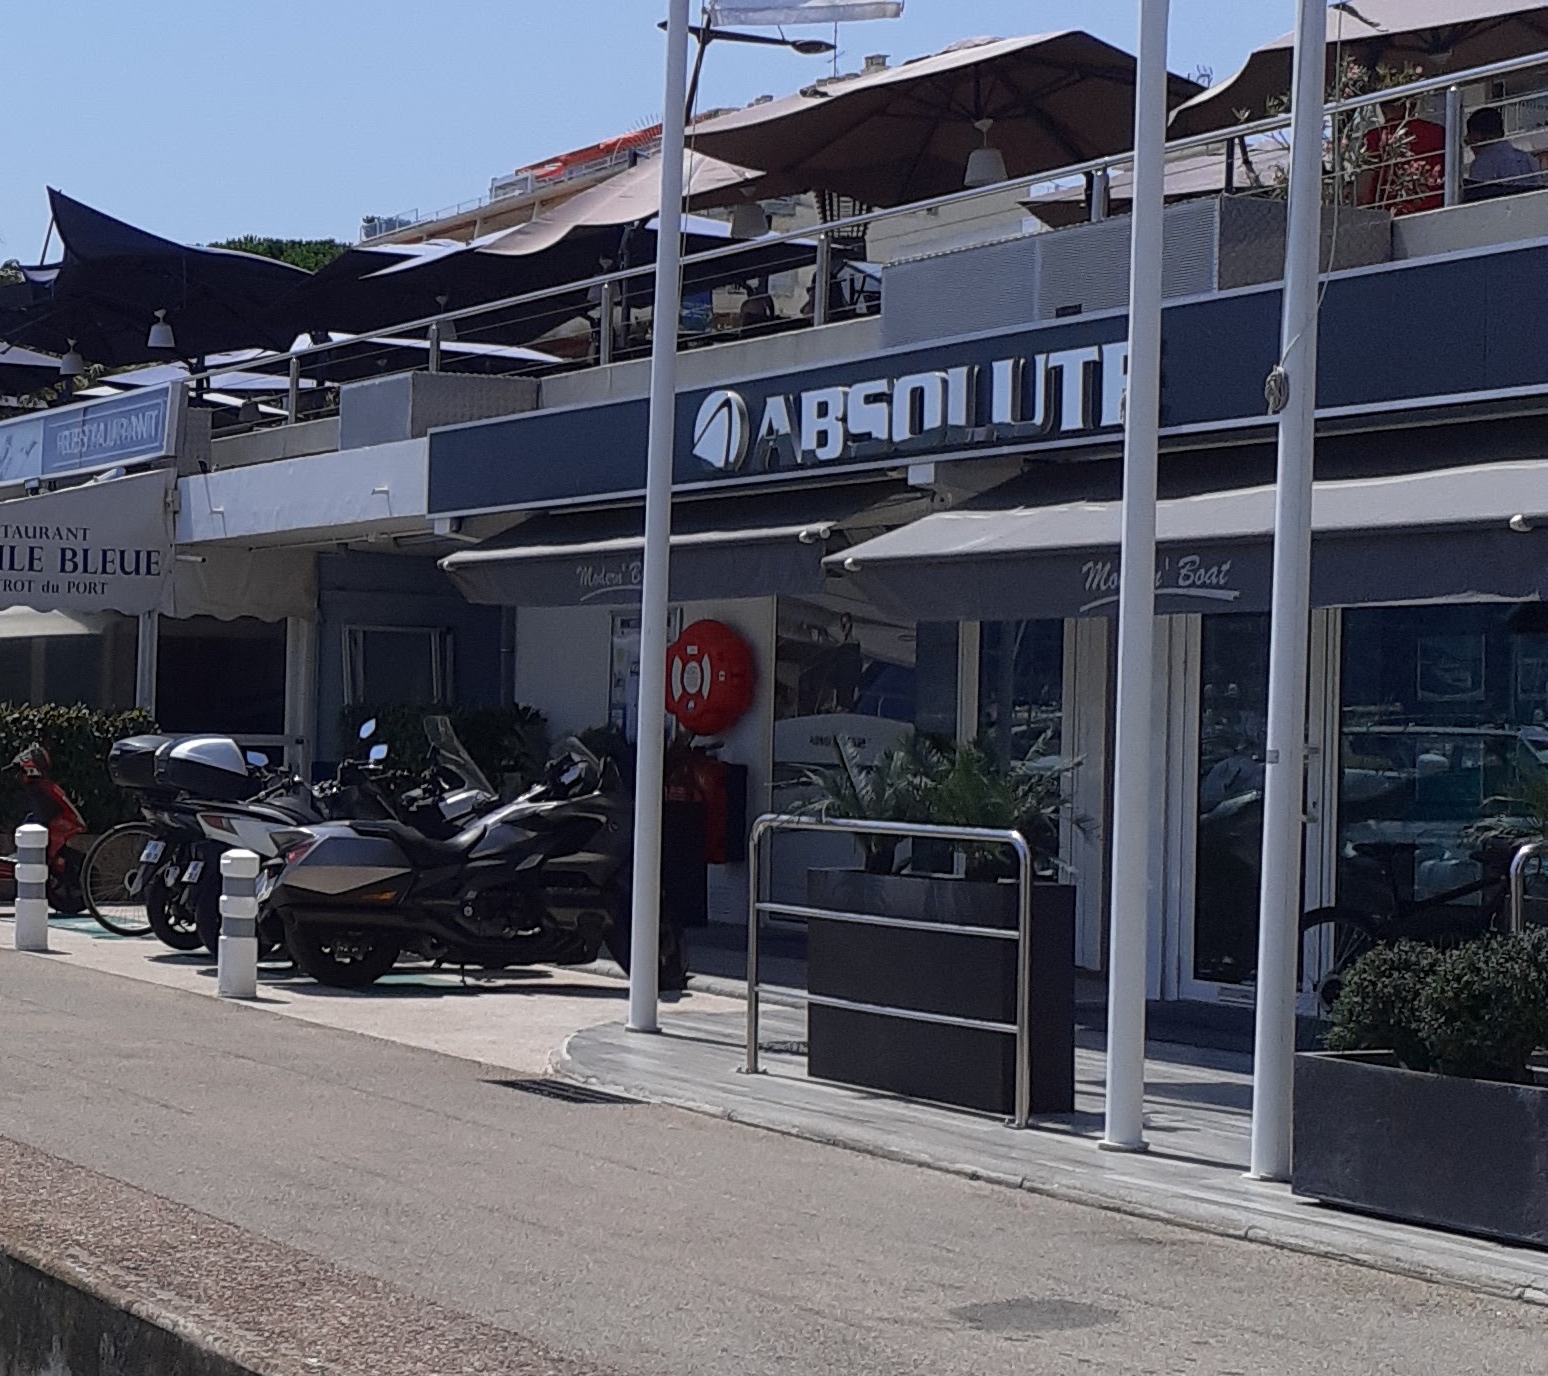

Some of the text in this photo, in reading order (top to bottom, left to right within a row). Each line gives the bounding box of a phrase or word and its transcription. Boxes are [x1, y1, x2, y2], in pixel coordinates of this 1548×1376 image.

[58, 546, 161, 577] BLEUE
[1081, 554, 1232, 592] Mon' Boat
[41, 578, 61, 594] du
[66, 580, 109, 595] PORT
